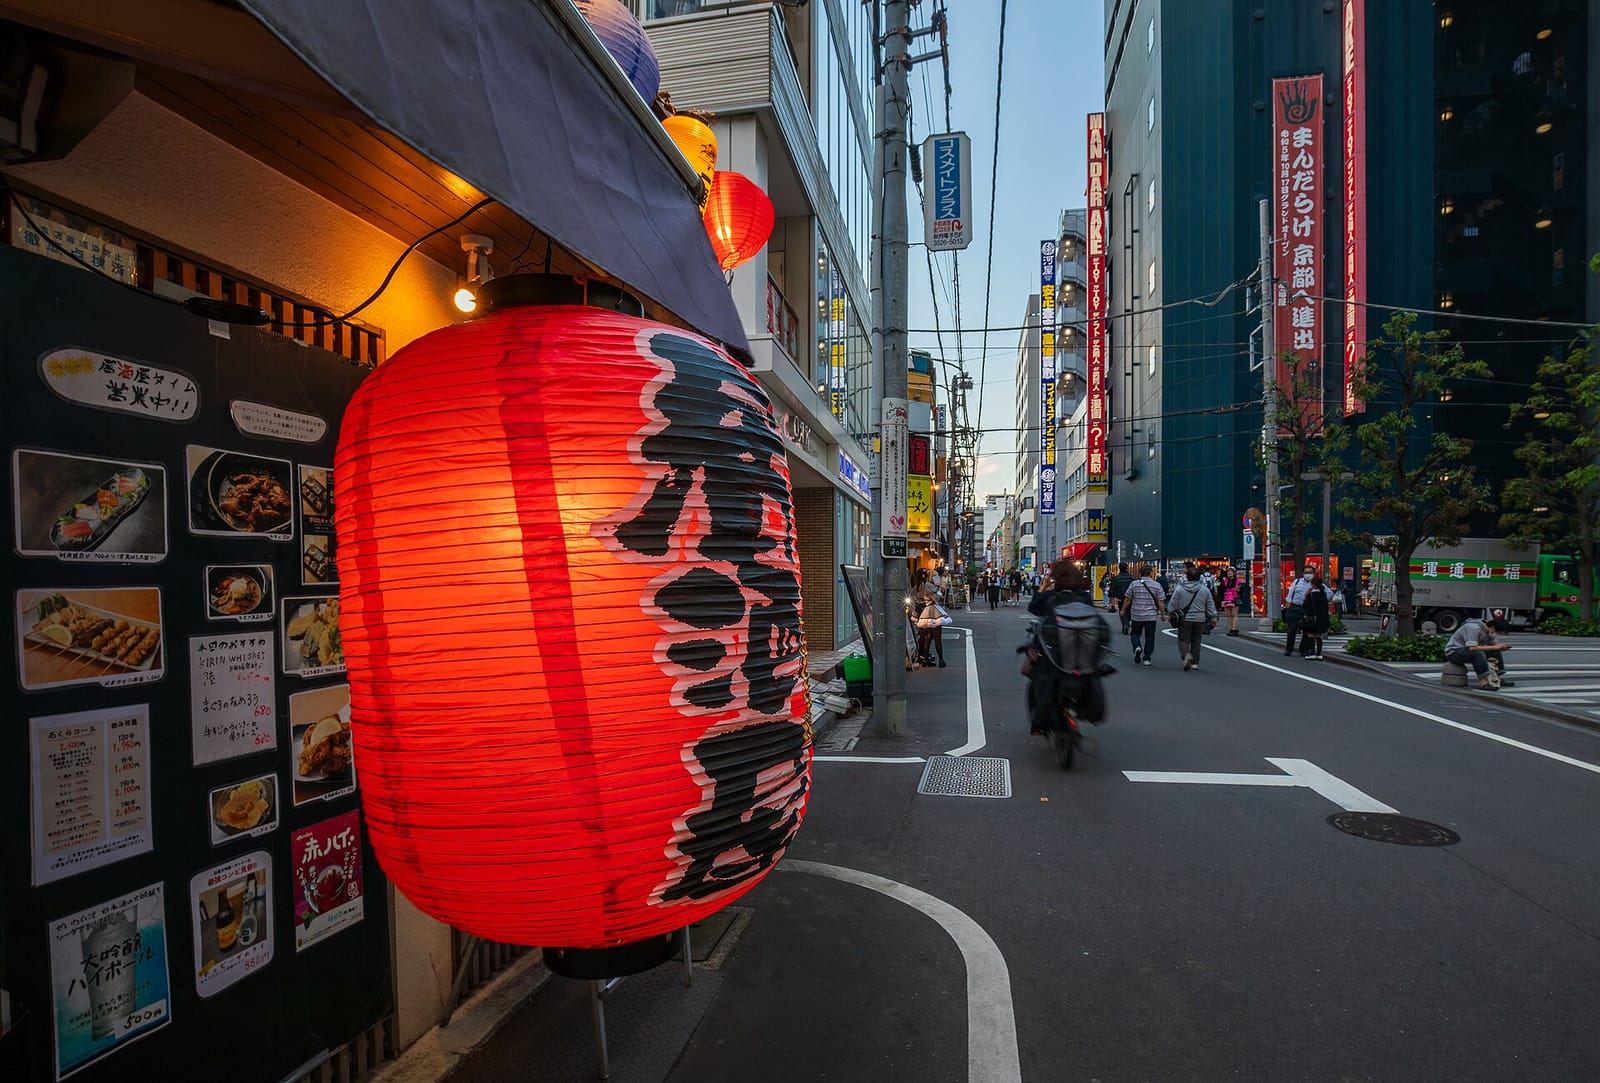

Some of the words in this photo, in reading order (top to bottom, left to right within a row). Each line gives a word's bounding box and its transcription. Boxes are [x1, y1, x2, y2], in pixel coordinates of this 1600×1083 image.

[939, 140, 957, 218] コスメイトプラス
[1292, 126, 1315, 234] まんだらけ
[1292, 244, 1316, 351] 京都へ進出
[98, 358, 195, 394] 居酒屋タイム
[254, 704, 271, 718] 680
[67, 946, 157, 997] ハイボール
